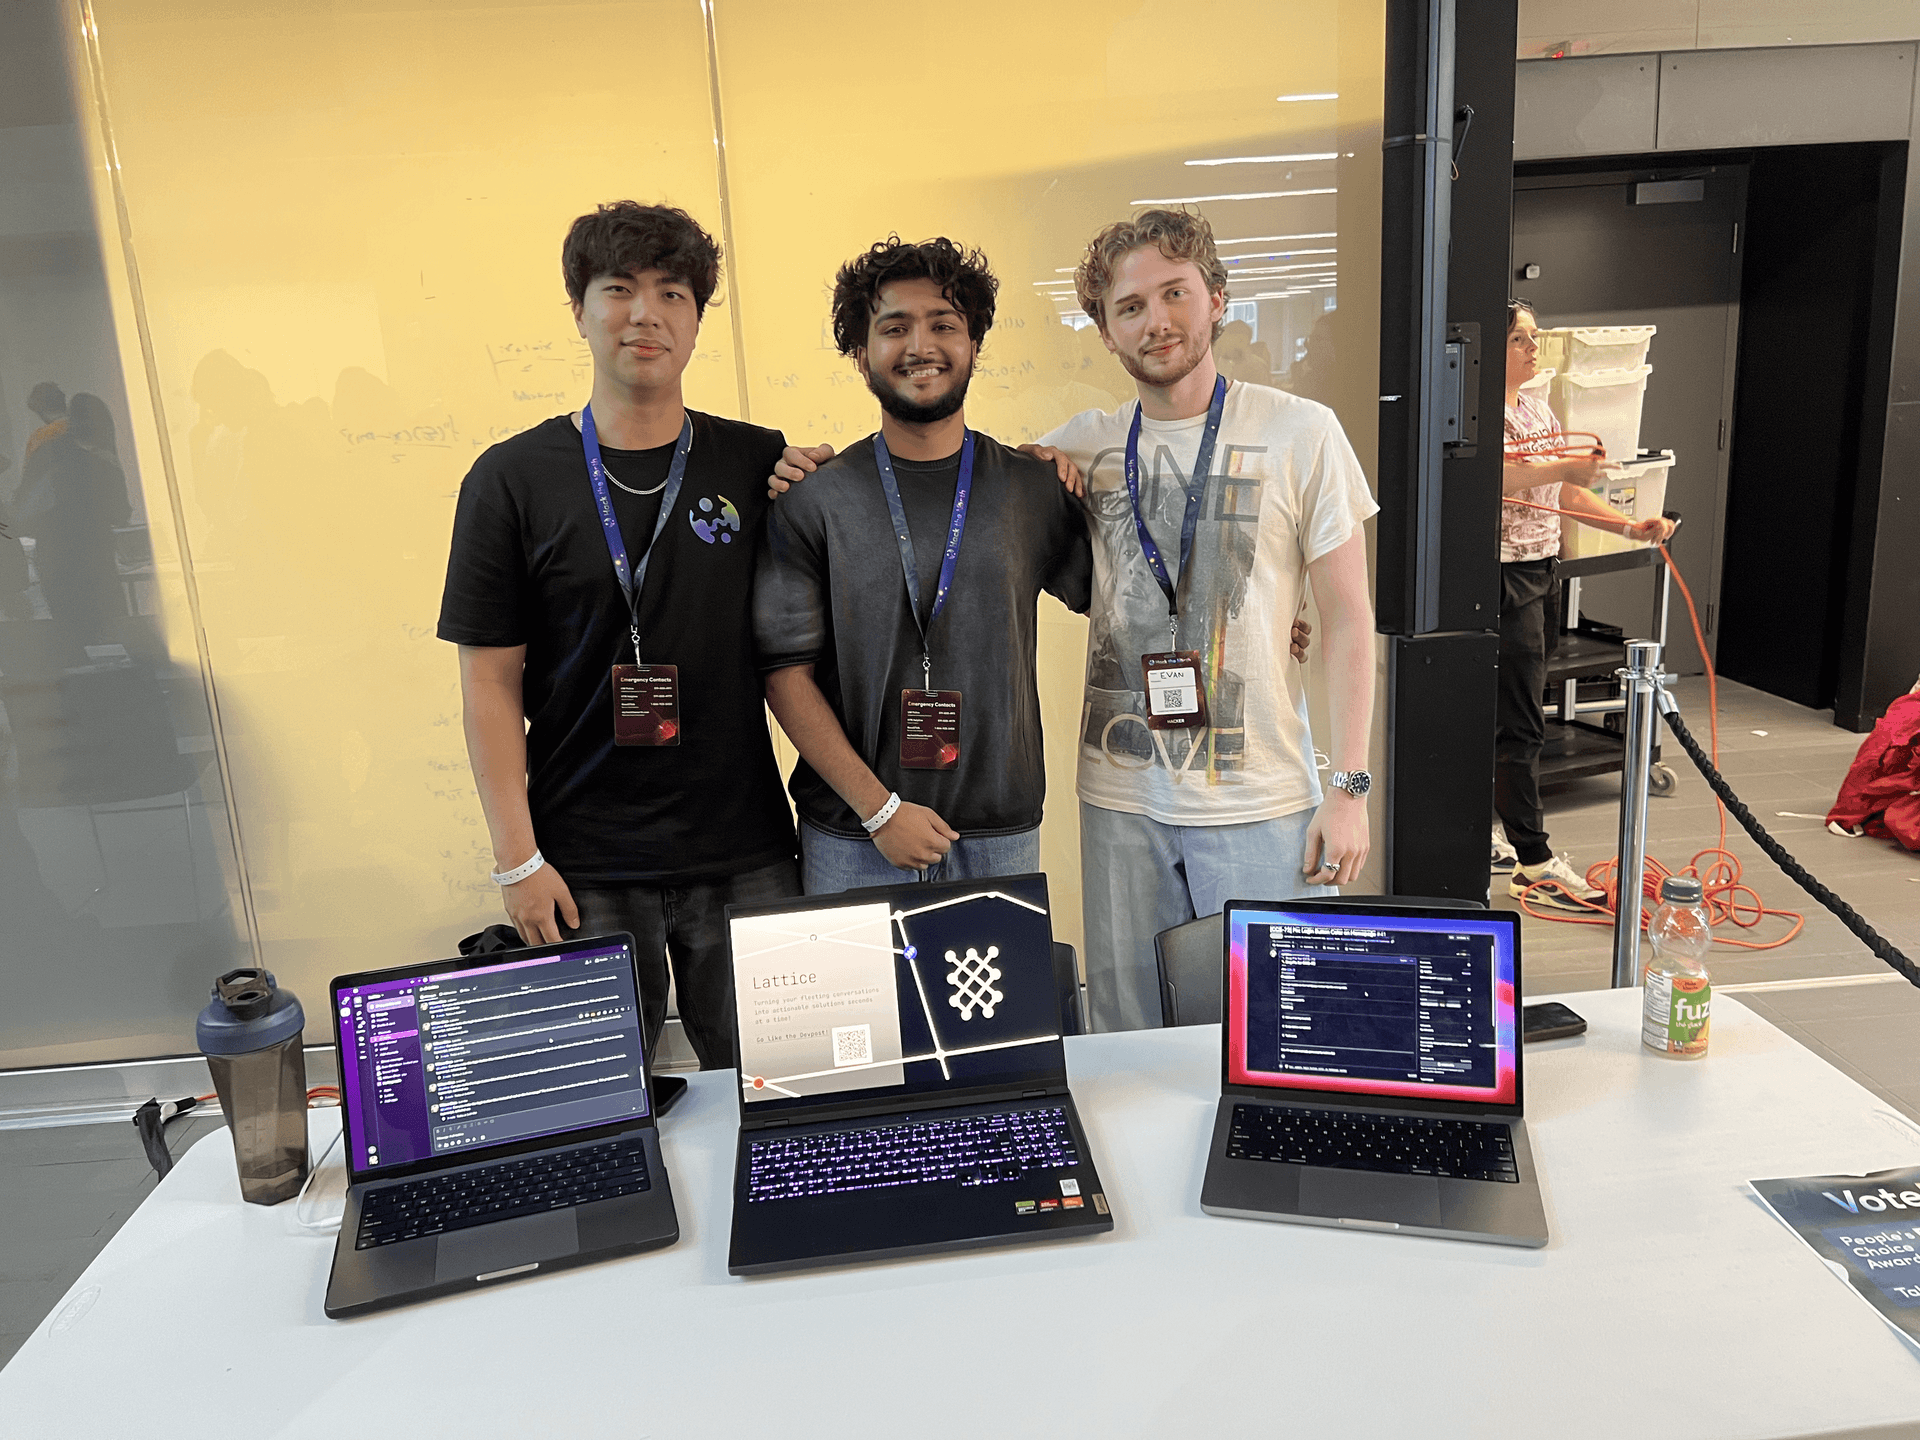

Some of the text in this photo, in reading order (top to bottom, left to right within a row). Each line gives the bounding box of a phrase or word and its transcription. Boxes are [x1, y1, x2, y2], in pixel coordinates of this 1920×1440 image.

[1088, 443, 1268, 522] ONE
[600, 496, 610, 516] Hack
[949, 528, 960, 547] Hack
[1160, 671, 1184, 680] EVAN
[1079, 701, 1244, 786] LOVE
[753, 972, 817, 990] Lattice
[754, 998, 780, 1007] Turning
[800, 992, 830, 1001] fleeting
[832, 987, 880, 998] conversations
[772, 1004, 809, 1014] actionable
[812, 1000, 845, 1009] solutions
[847, 997, 873, 1005] seconds
[773, 1015, 791, 1023] time!
[799, 1029, 829, 1038] Devpost!
[1821, 1188, 1920, 1214] Vote
[1839, 1231, 1916, 1247] People's
[1853, 1244, 1915, 1258] Choice
